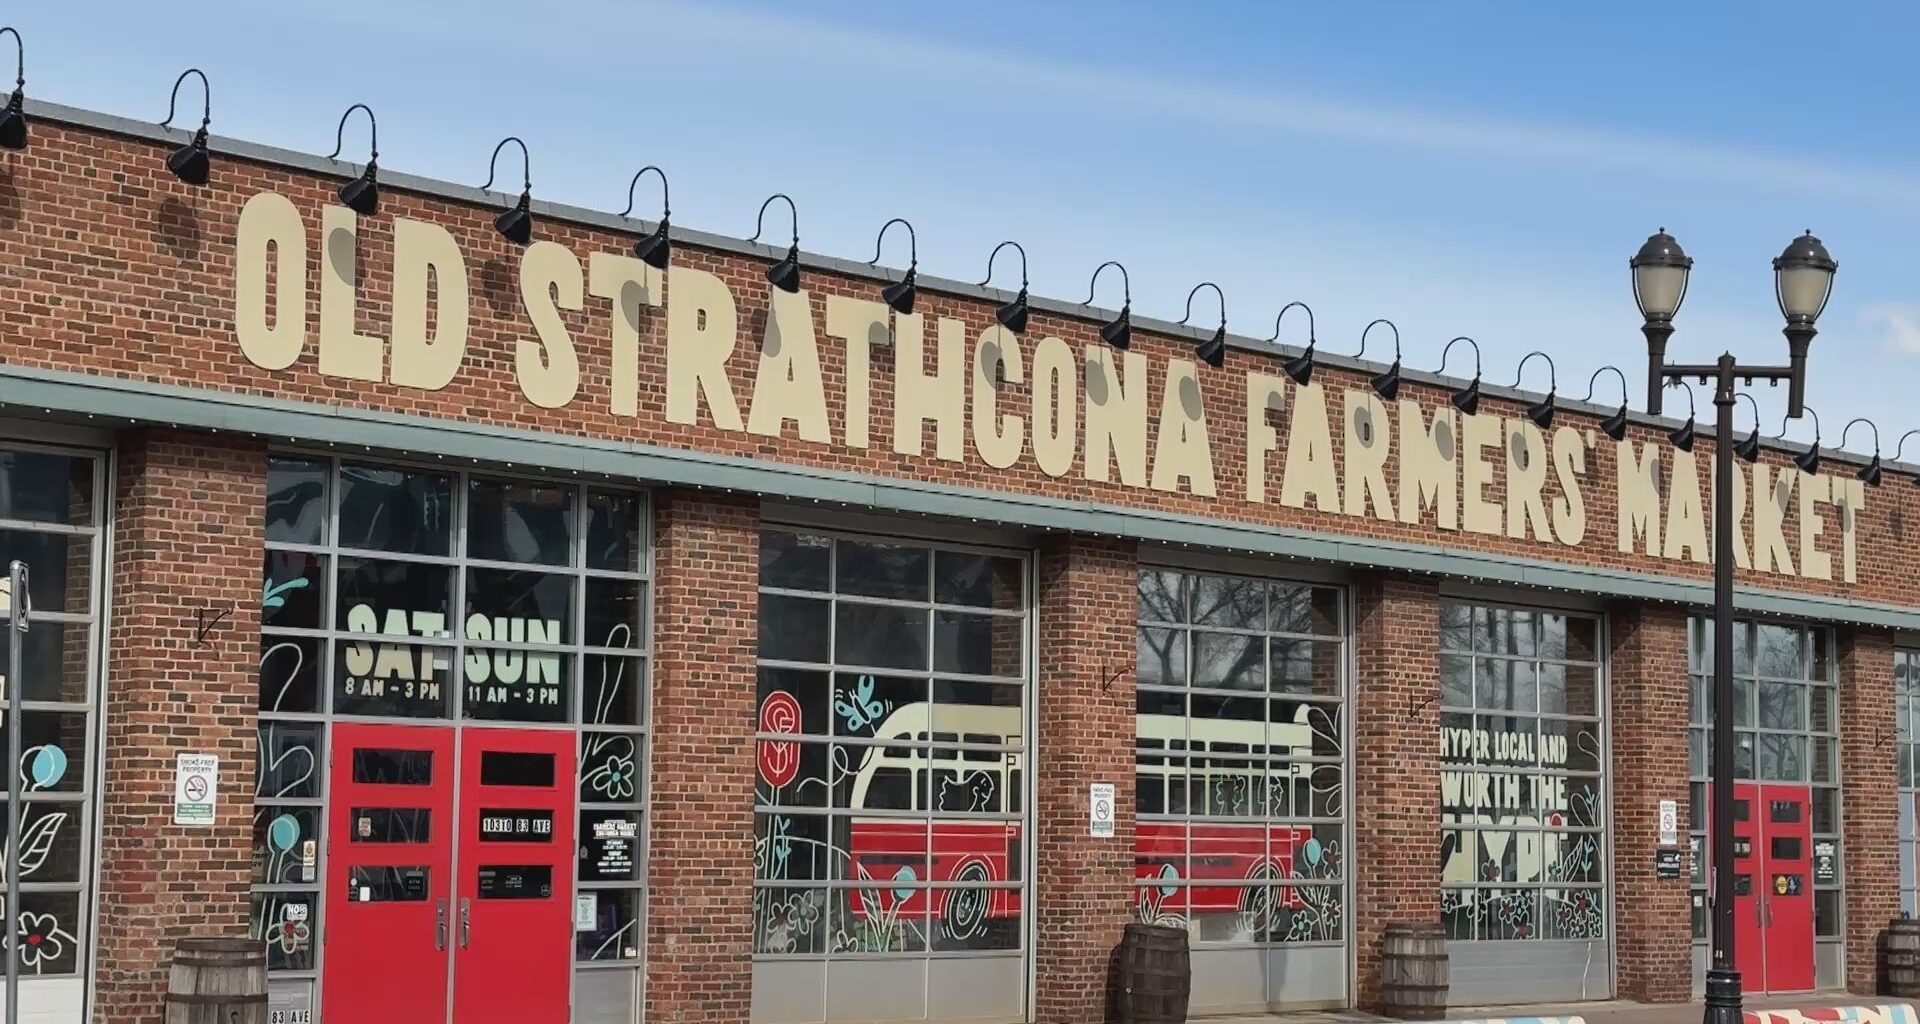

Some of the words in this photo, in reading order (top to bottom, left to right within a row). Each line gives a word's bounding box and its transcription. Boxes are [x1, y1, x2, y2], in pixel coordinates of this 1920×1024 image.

[235, 192, 469, 391] OLD
[515, 240, 1217, 498] STRATHCONA
[1247, 371, 1595, 546] FARMERS'
[1617, 440, 1865, 584] MARKET
[345, 604, 445, 681] SAT
[464, 613, 560, 684] SUN
[345, 677, 355, 695] 8
[361, 679, 384, 697] AM
[405, 682, 414, 698] 3
[420, 682, 440, 700] PM
[468, 686, 481, 702] 11
[487, 687, 507, 703] AM
[526, 688, 536, 704] 3
[540, 688, 559, 705] PM
[1440, 727, 1490, 760] HYPER
[1495, 731, 1535, 762] LOCAL
[1540, 734, 1568, 764] AND
[1440, 762, 1520, 809] WORTH
[1526, 766, 1568, 810] THE
[483, 818, 512, 832] 10310
[516, 818, 528, 832] 83
[533, 819, 551, 833] AVE
[271, 1011, 284, 1024] 83
[291, 1010, 309, 1023] AVE
